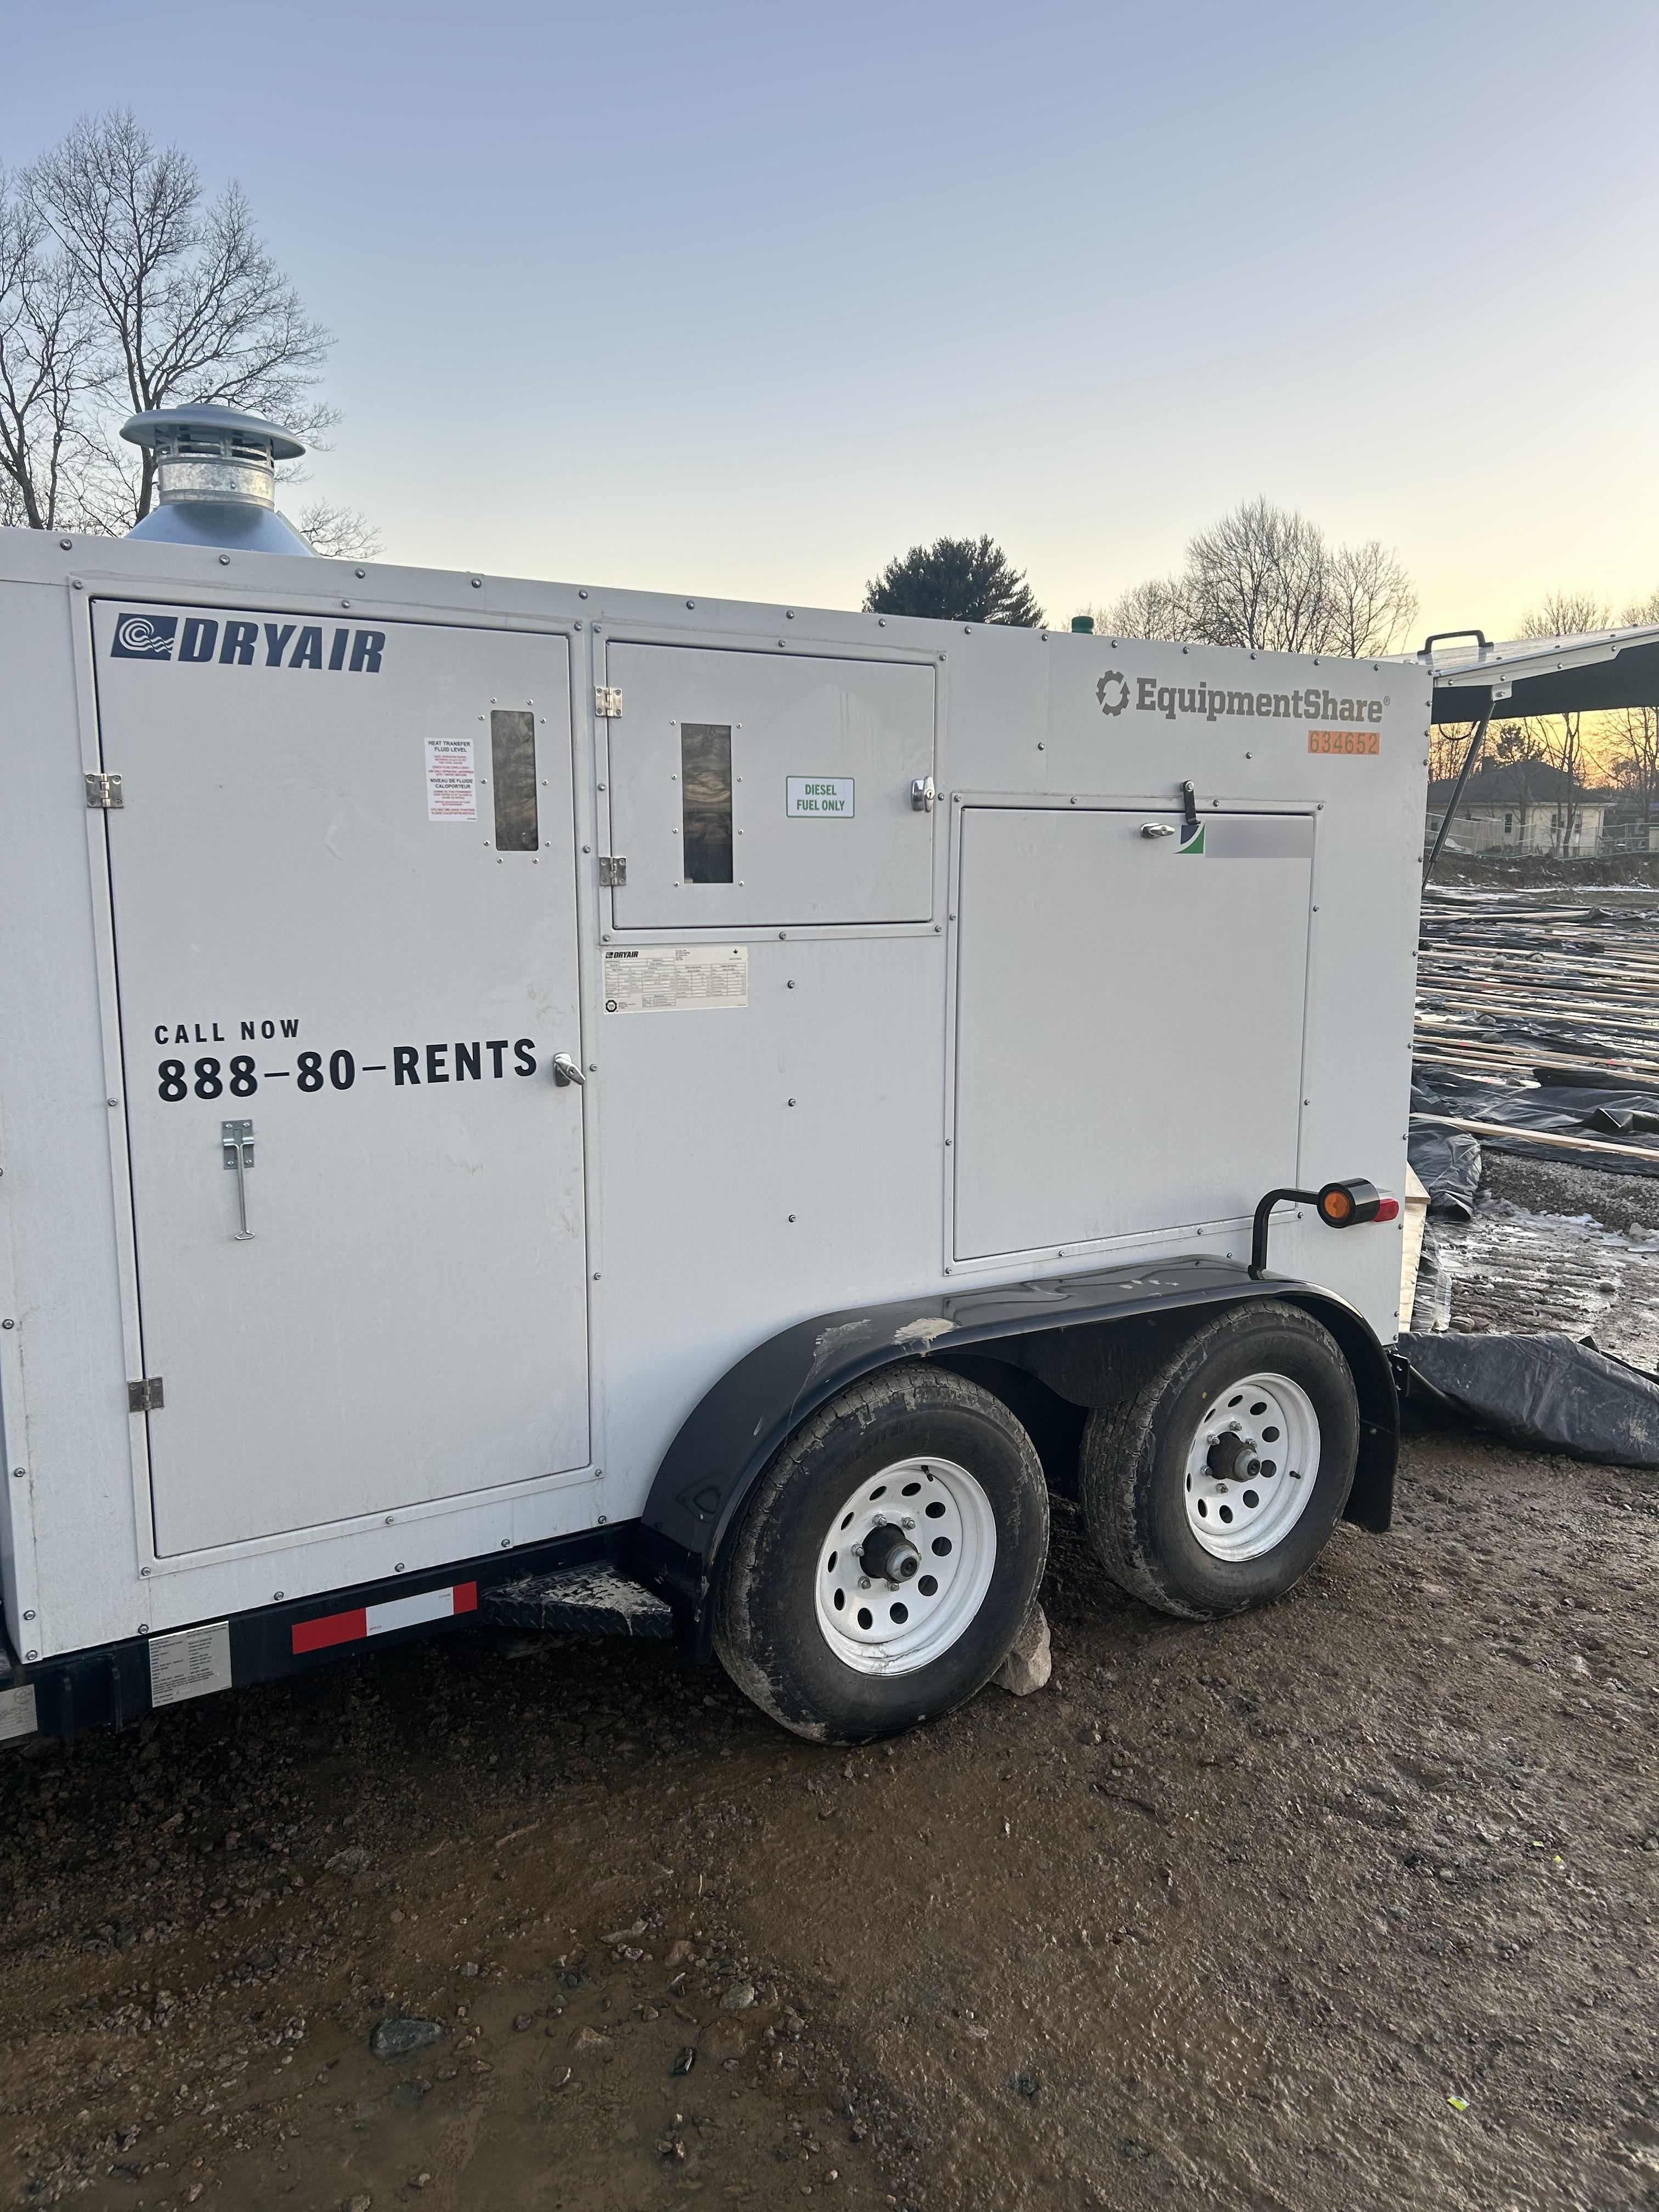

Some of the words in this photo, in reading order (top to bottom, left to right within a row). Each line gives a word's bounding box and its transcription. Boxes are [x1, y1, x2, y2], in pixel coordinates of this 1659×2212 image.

[178, 617, 386, 673] DRYAIR
[1310, 730, 1378, 754] 634652
[805, 784, 837, 795] DIESEL
[797, 799, 820, 811] FUEL
[821, 800, 845, 811] ONLY
[154, 1022, 225, 1045] CALL
[241, 1019, 300, 1040] NOW
[158, 1038, 538, 1102] 888-80-RENTS
